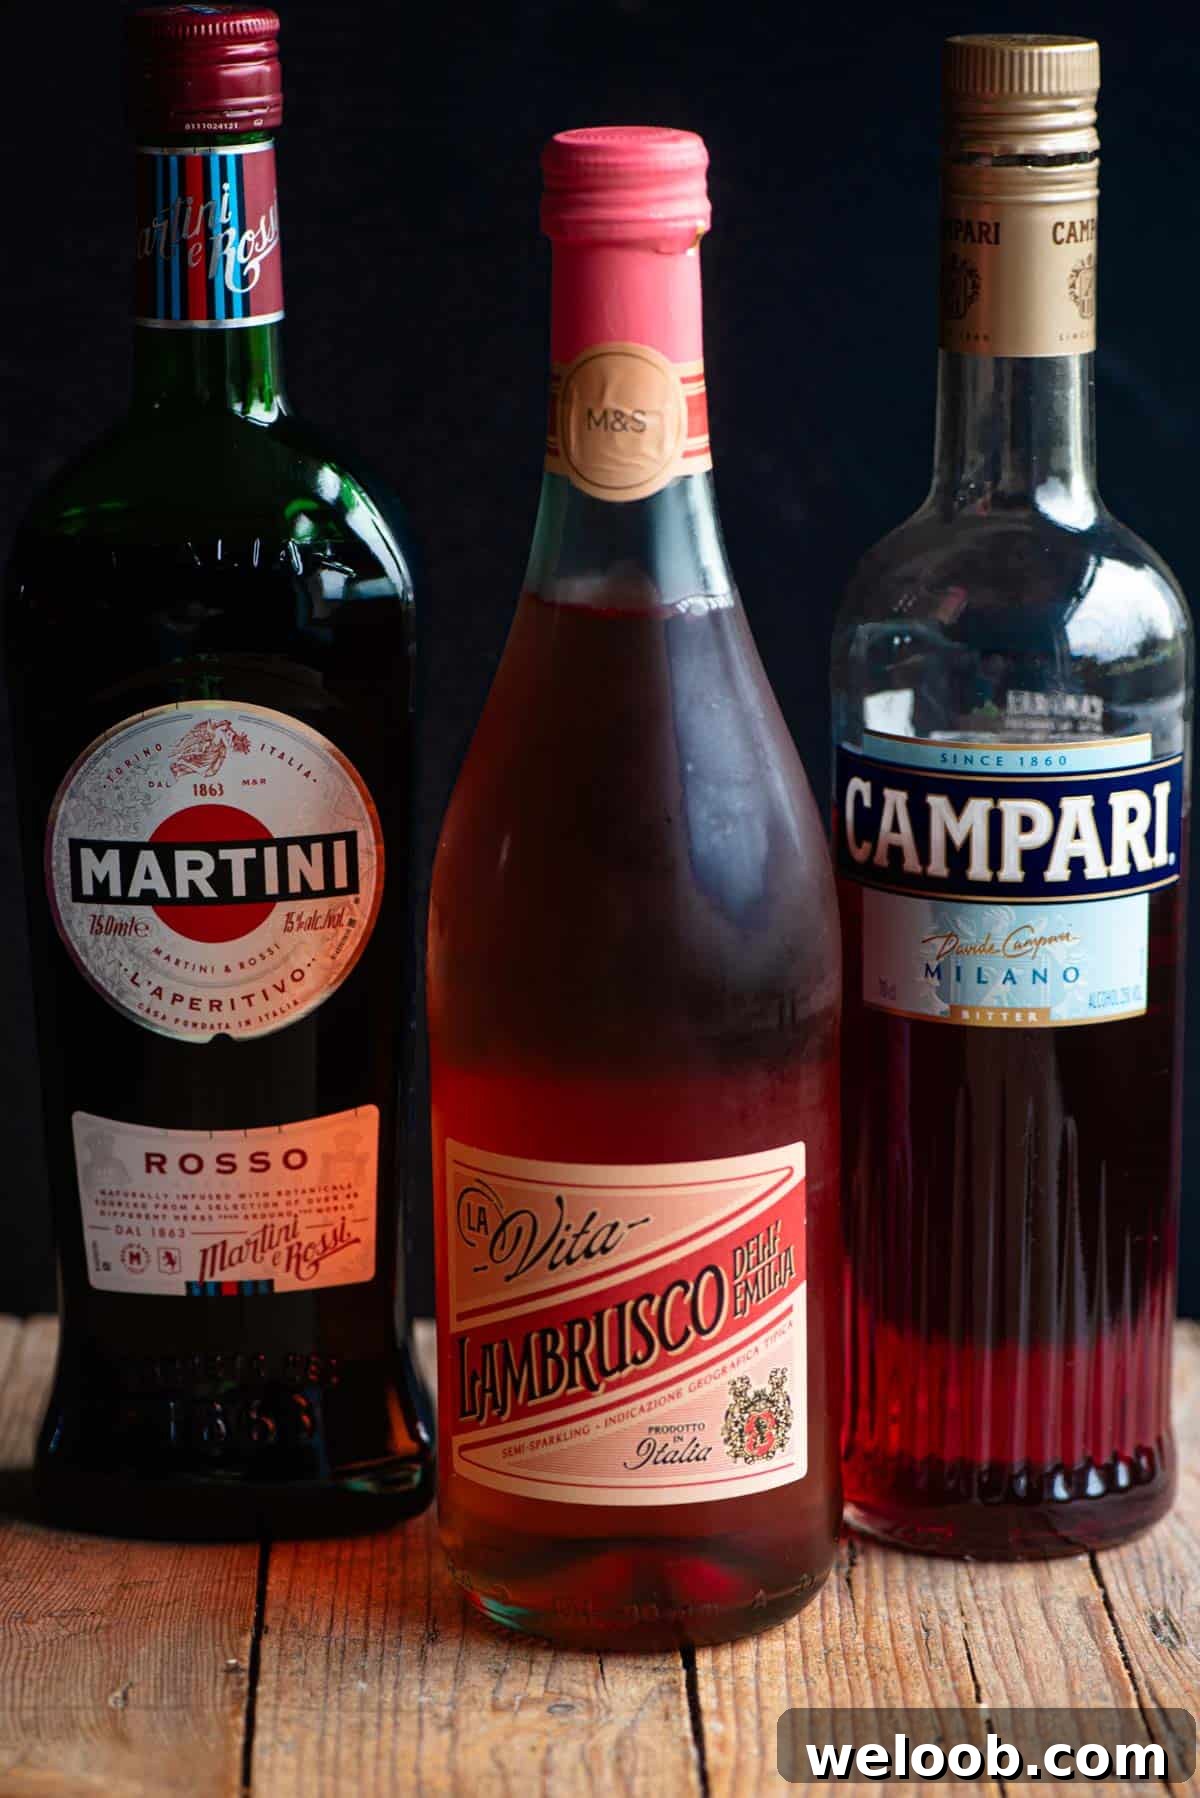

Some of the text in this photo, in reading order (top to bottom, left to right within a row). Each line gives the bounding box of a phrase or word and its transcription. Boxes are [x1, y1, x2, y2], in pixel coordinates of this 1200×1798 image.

[946, 218, 1000, 245] PARI
[586, 408, 647, 433] M&S
[107, 743, 162, 783] TORINO
[260, 743, 311, 778] ITALIA
[941, 752, 1067, 767] SINCE 1860
[193, 783, 224, 797] 1863
[79, 838, 350, 899] MARTINI
[152, 943, 281, 973] MARTINI & ROSSI
[924, 962, 1080, 985] MILANO
[130, 968, 305, 1013] L'APERITIVO
[961, 1009, 1039, 1023] BITTER
[145, 1148, 308, 1175] ROSSO
[115, 1224, 185, 1238] DAL 1863
[466, 1202, 489, 1236] LA
[198, 1213, 299, 1287] Martini
[489, 1195, 626, 1282] Vita
[272, 1250, 281, 1267] e
[733, 1245, 796, 1320] EMILIA
[457, 1264, 729, 1424] LAMBRUSCO
[501, 1424, 591, 1458] SEMI-SPARKLING
[604, 1388, 683, 1428] INDICAZIONE
[688, 1346, 759, 1393] GEOGRAFICA
[648, 1422, 705, 1434] PRODOTTO
[673, 1435, 684, 1443] IN
[623, 1437, 712, 1471] Italia
